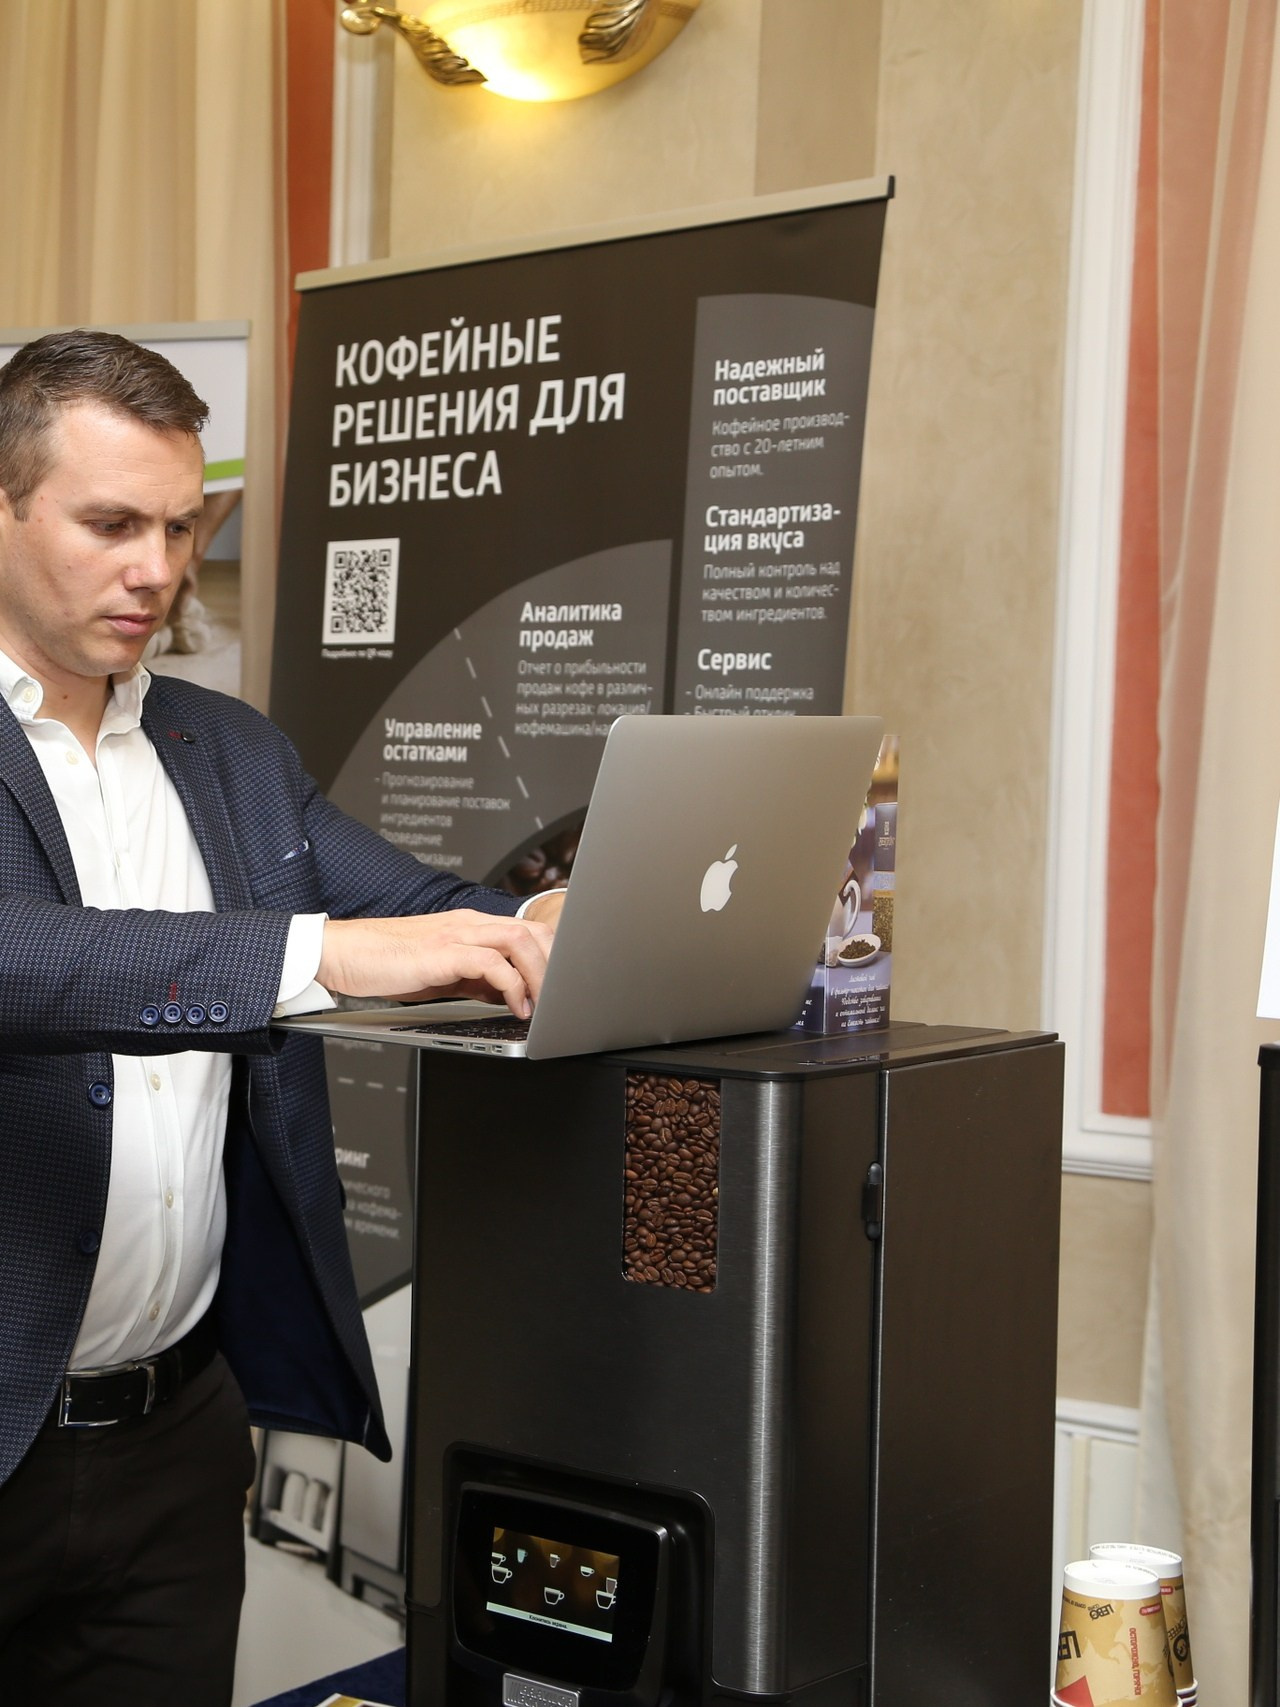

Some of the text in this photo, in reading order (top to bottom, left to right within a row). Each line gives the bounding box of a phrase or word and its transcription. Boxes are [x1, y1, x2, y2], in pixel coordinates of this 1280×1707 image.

[335, 314, 562, 388] КОФЕЙНЫЕ
[714, 347, 825, 382] Надежный
[713, 378, 826, 406] поставщик
[332, 372, 626, 447] РЕШЕНИЯ ДЛЯ
[712, 411, 850, 438] Кофейное производ-
[711, 437, 824, 457] ство с 20-летним
[329, 449, 503, 507] БИЗНЕСА
[709, 463, 764, 479] опытом.
[705, 502, 841, 530] Стандартиза-
[703, 530, 805, 555] ция вкуса
[703, 561, 841, 581] Полный контроль над
[702, 586, 771, 602] качеством
[773, 587, 783, 600] и
[520, 601, 623, 623] Аналитика
[701, 608, 733, 623] твом
[519, 628, 594, 653] продаж
[517, 658, 647, 678] Отчет о прибыльности
[697, 648, 772, 676] Сервис
[694, 684, 814, 704] Онлайн поддержка
[384, 718, 482, 743] Управление
[382, 744, 468, 762] остатками
[1089, 1603, 1114, 1621] LEBO
